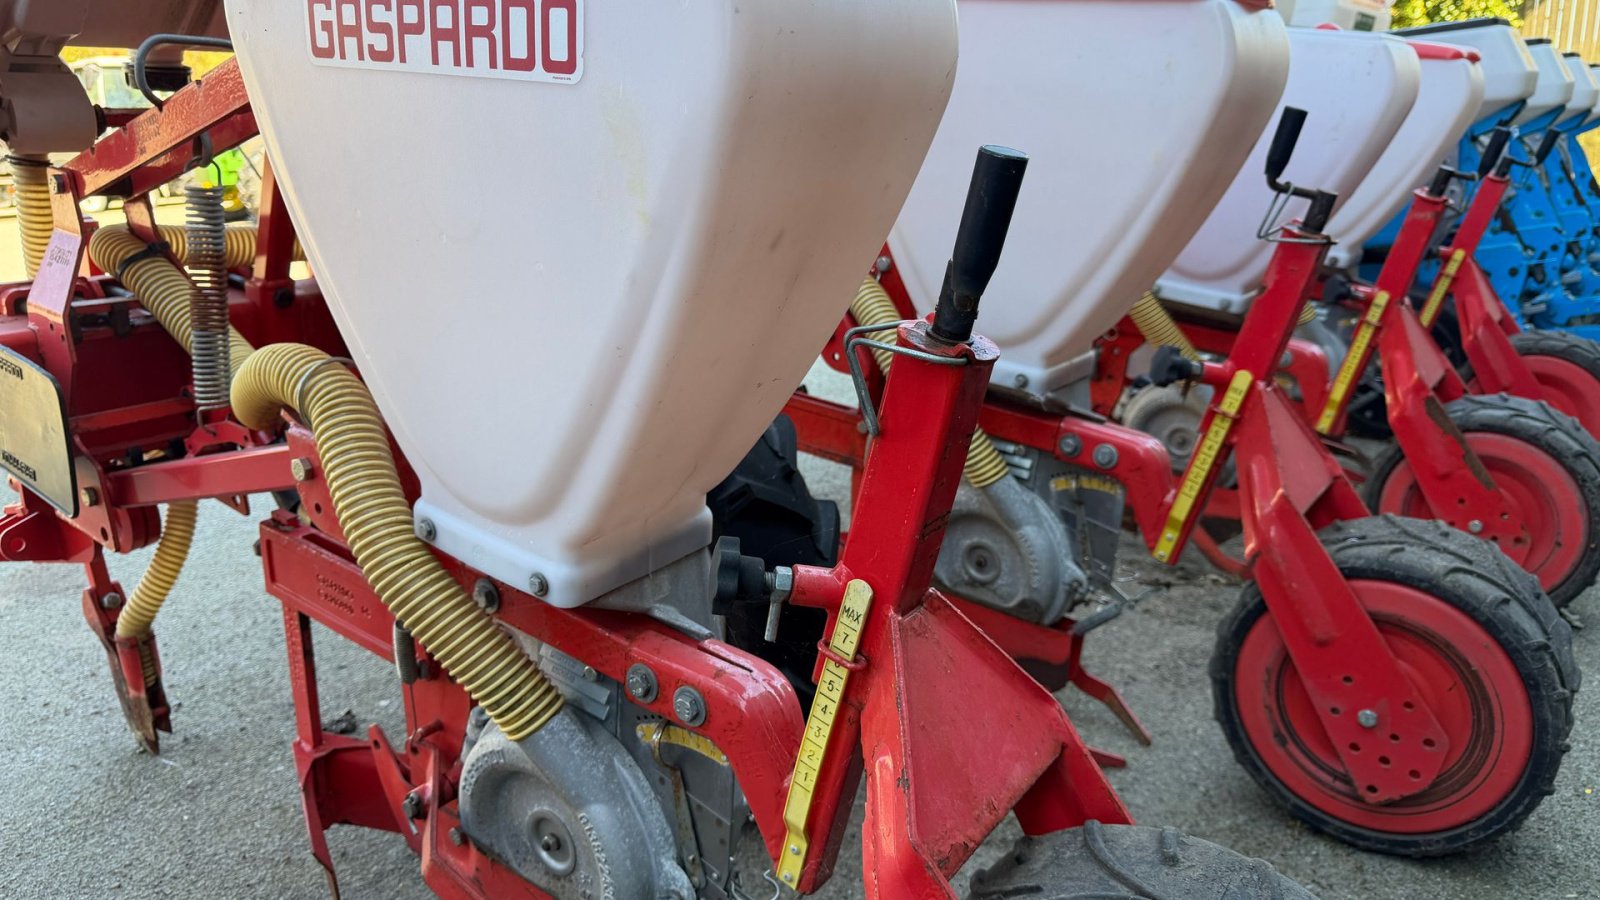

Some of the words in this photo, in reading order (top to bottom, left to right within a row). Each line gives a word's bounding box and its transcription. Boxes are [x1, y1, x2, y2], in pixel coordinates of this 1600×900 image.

[307, 0, 577, 75] GASPARDO
[842, 605, 862, 625] MAX
[842, 631, 849, 644] 7
[827, 680, 835, 692] 5
[821, 704, 828, 715] 4
[814, 726, 822, 738] 3
[807, 749, 815, 761] 2
[803, 772, 808, 781] 1
